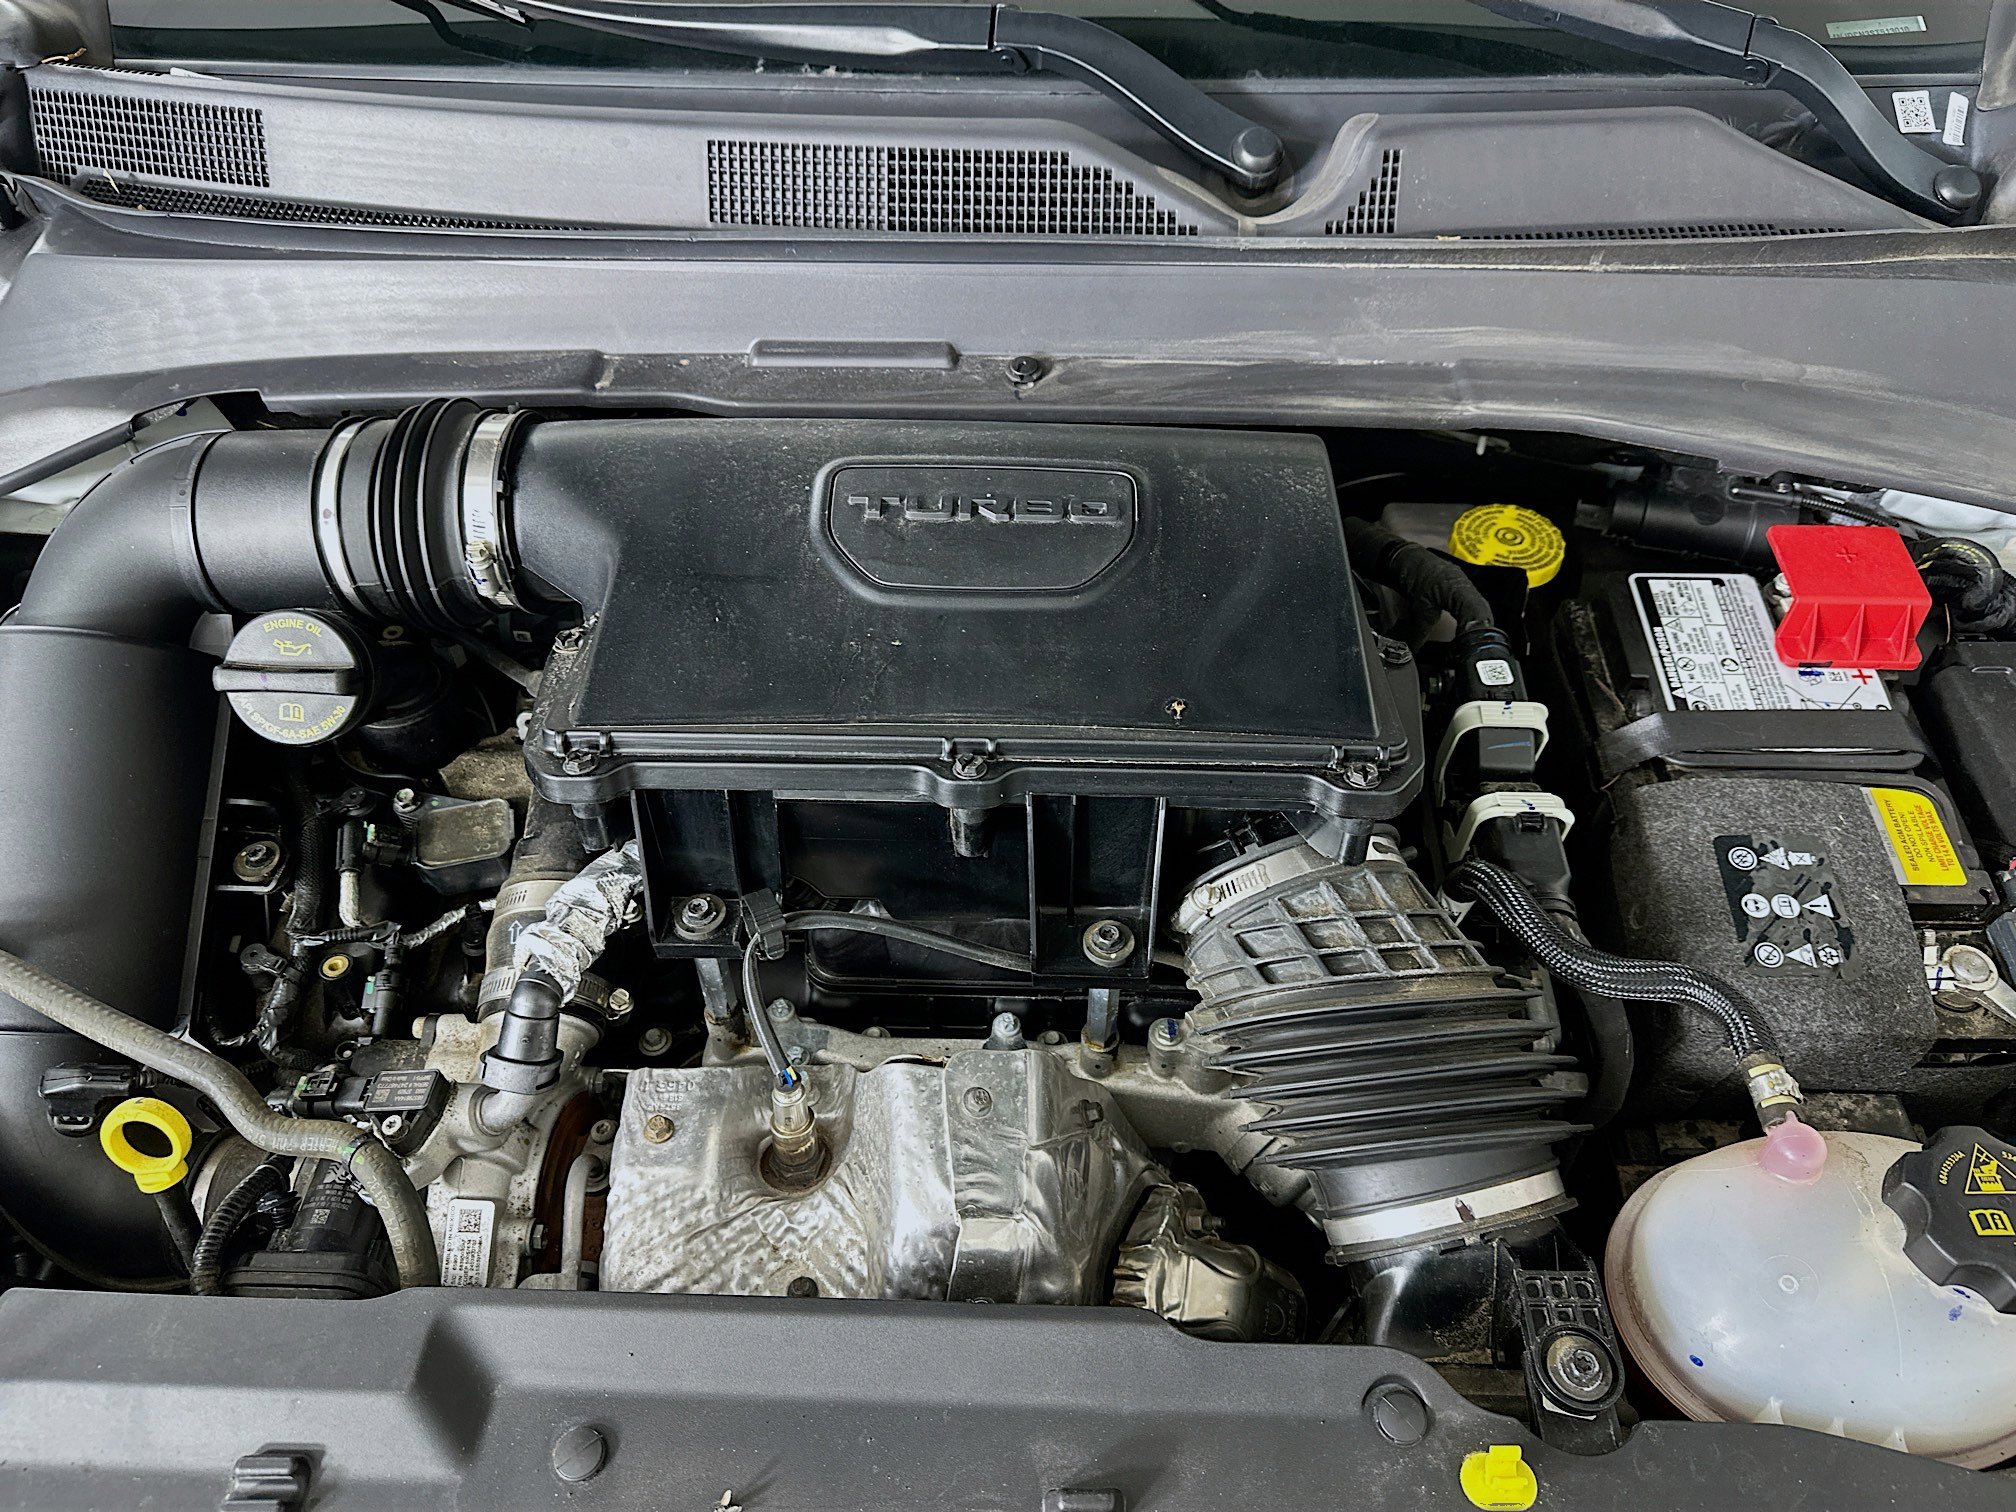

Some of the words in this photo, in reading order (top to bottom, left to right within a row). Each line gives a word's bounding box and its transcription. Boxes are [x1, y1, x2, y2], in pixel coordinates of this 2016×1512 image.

[848, 495, 1122, 522] TURBO
[263, 618, 303, 633] ENGINE
[305, 623, 323, 637] OIL
[321, 705, 346, 731] 5W-30
[1884, 800, 1901, 828] BATTERY
[1914, 805, 1930, 829] VOLTAGE
[1897, 830, 1908, 844] AGM
[1908, 835, 1918, 847] NOT
[1925, 831, 1941, 854] CHARGE
[1931, 826, 1944, 843] VOLTS
[1903, 846, 1919, 871] SEALED
[1914, 849, 1923, 858] DO
[1936, 856, 1949, 871] LIMIT
[299, 1137, 339, 1152] HEATER
[448, 1205, 456, 1231] MEXICO
